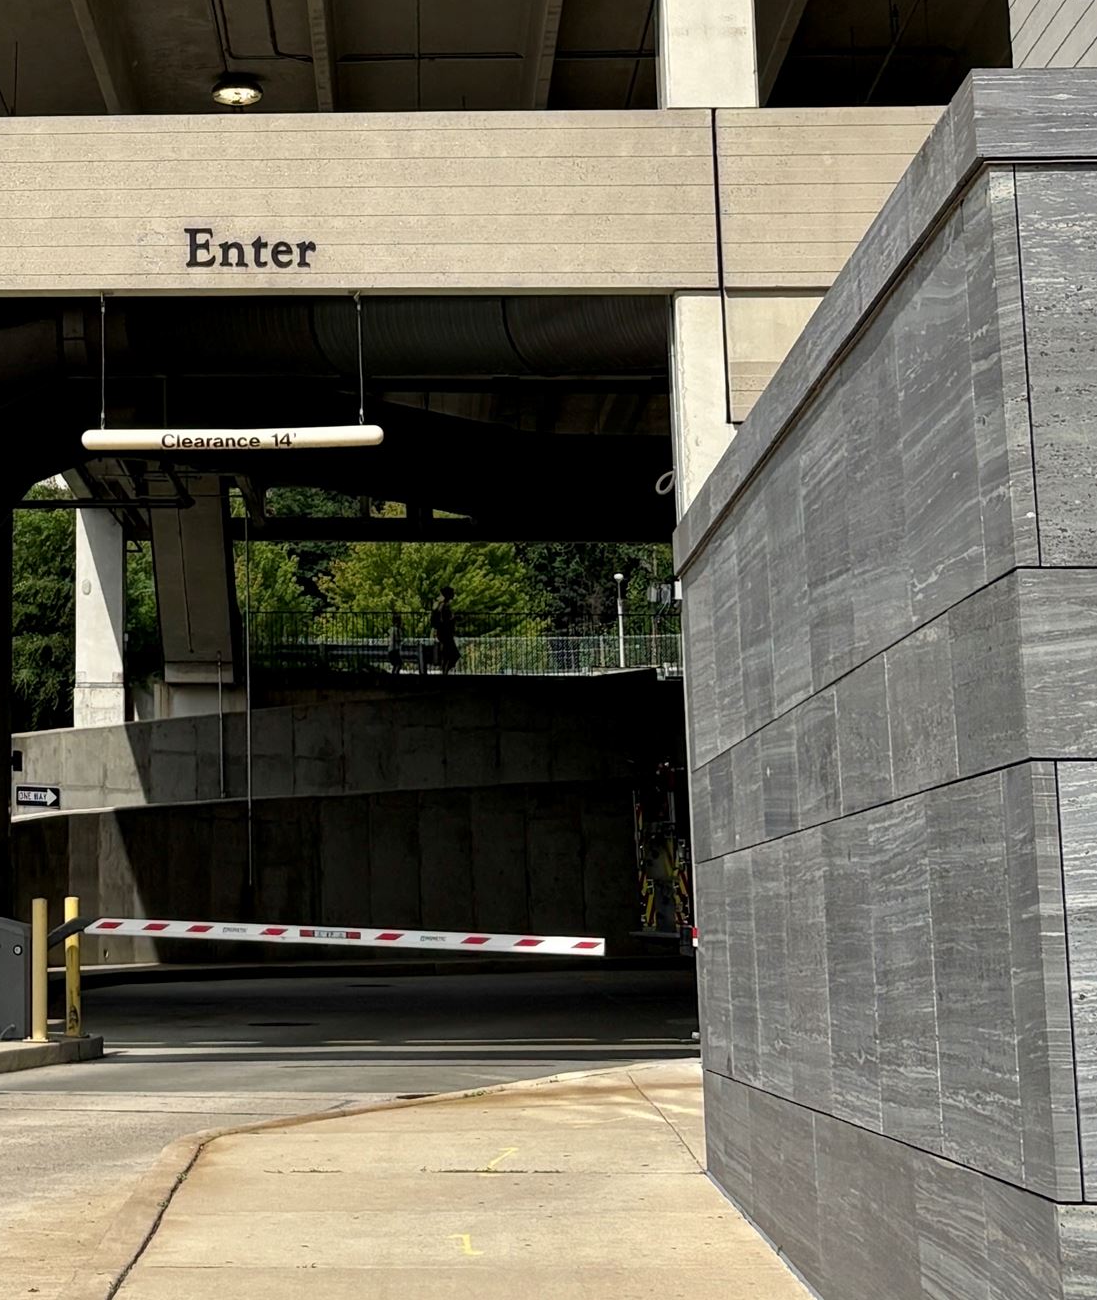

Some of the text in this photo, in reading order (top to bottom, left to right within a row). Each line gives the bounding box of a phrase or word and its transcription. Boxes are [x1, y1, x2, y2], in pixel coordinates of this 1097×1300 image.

[184, 227, 317, 269] Enter
[161, 432, 297, 448] Clearance 14'
[18, 791, 47, 800] ONE WAY
